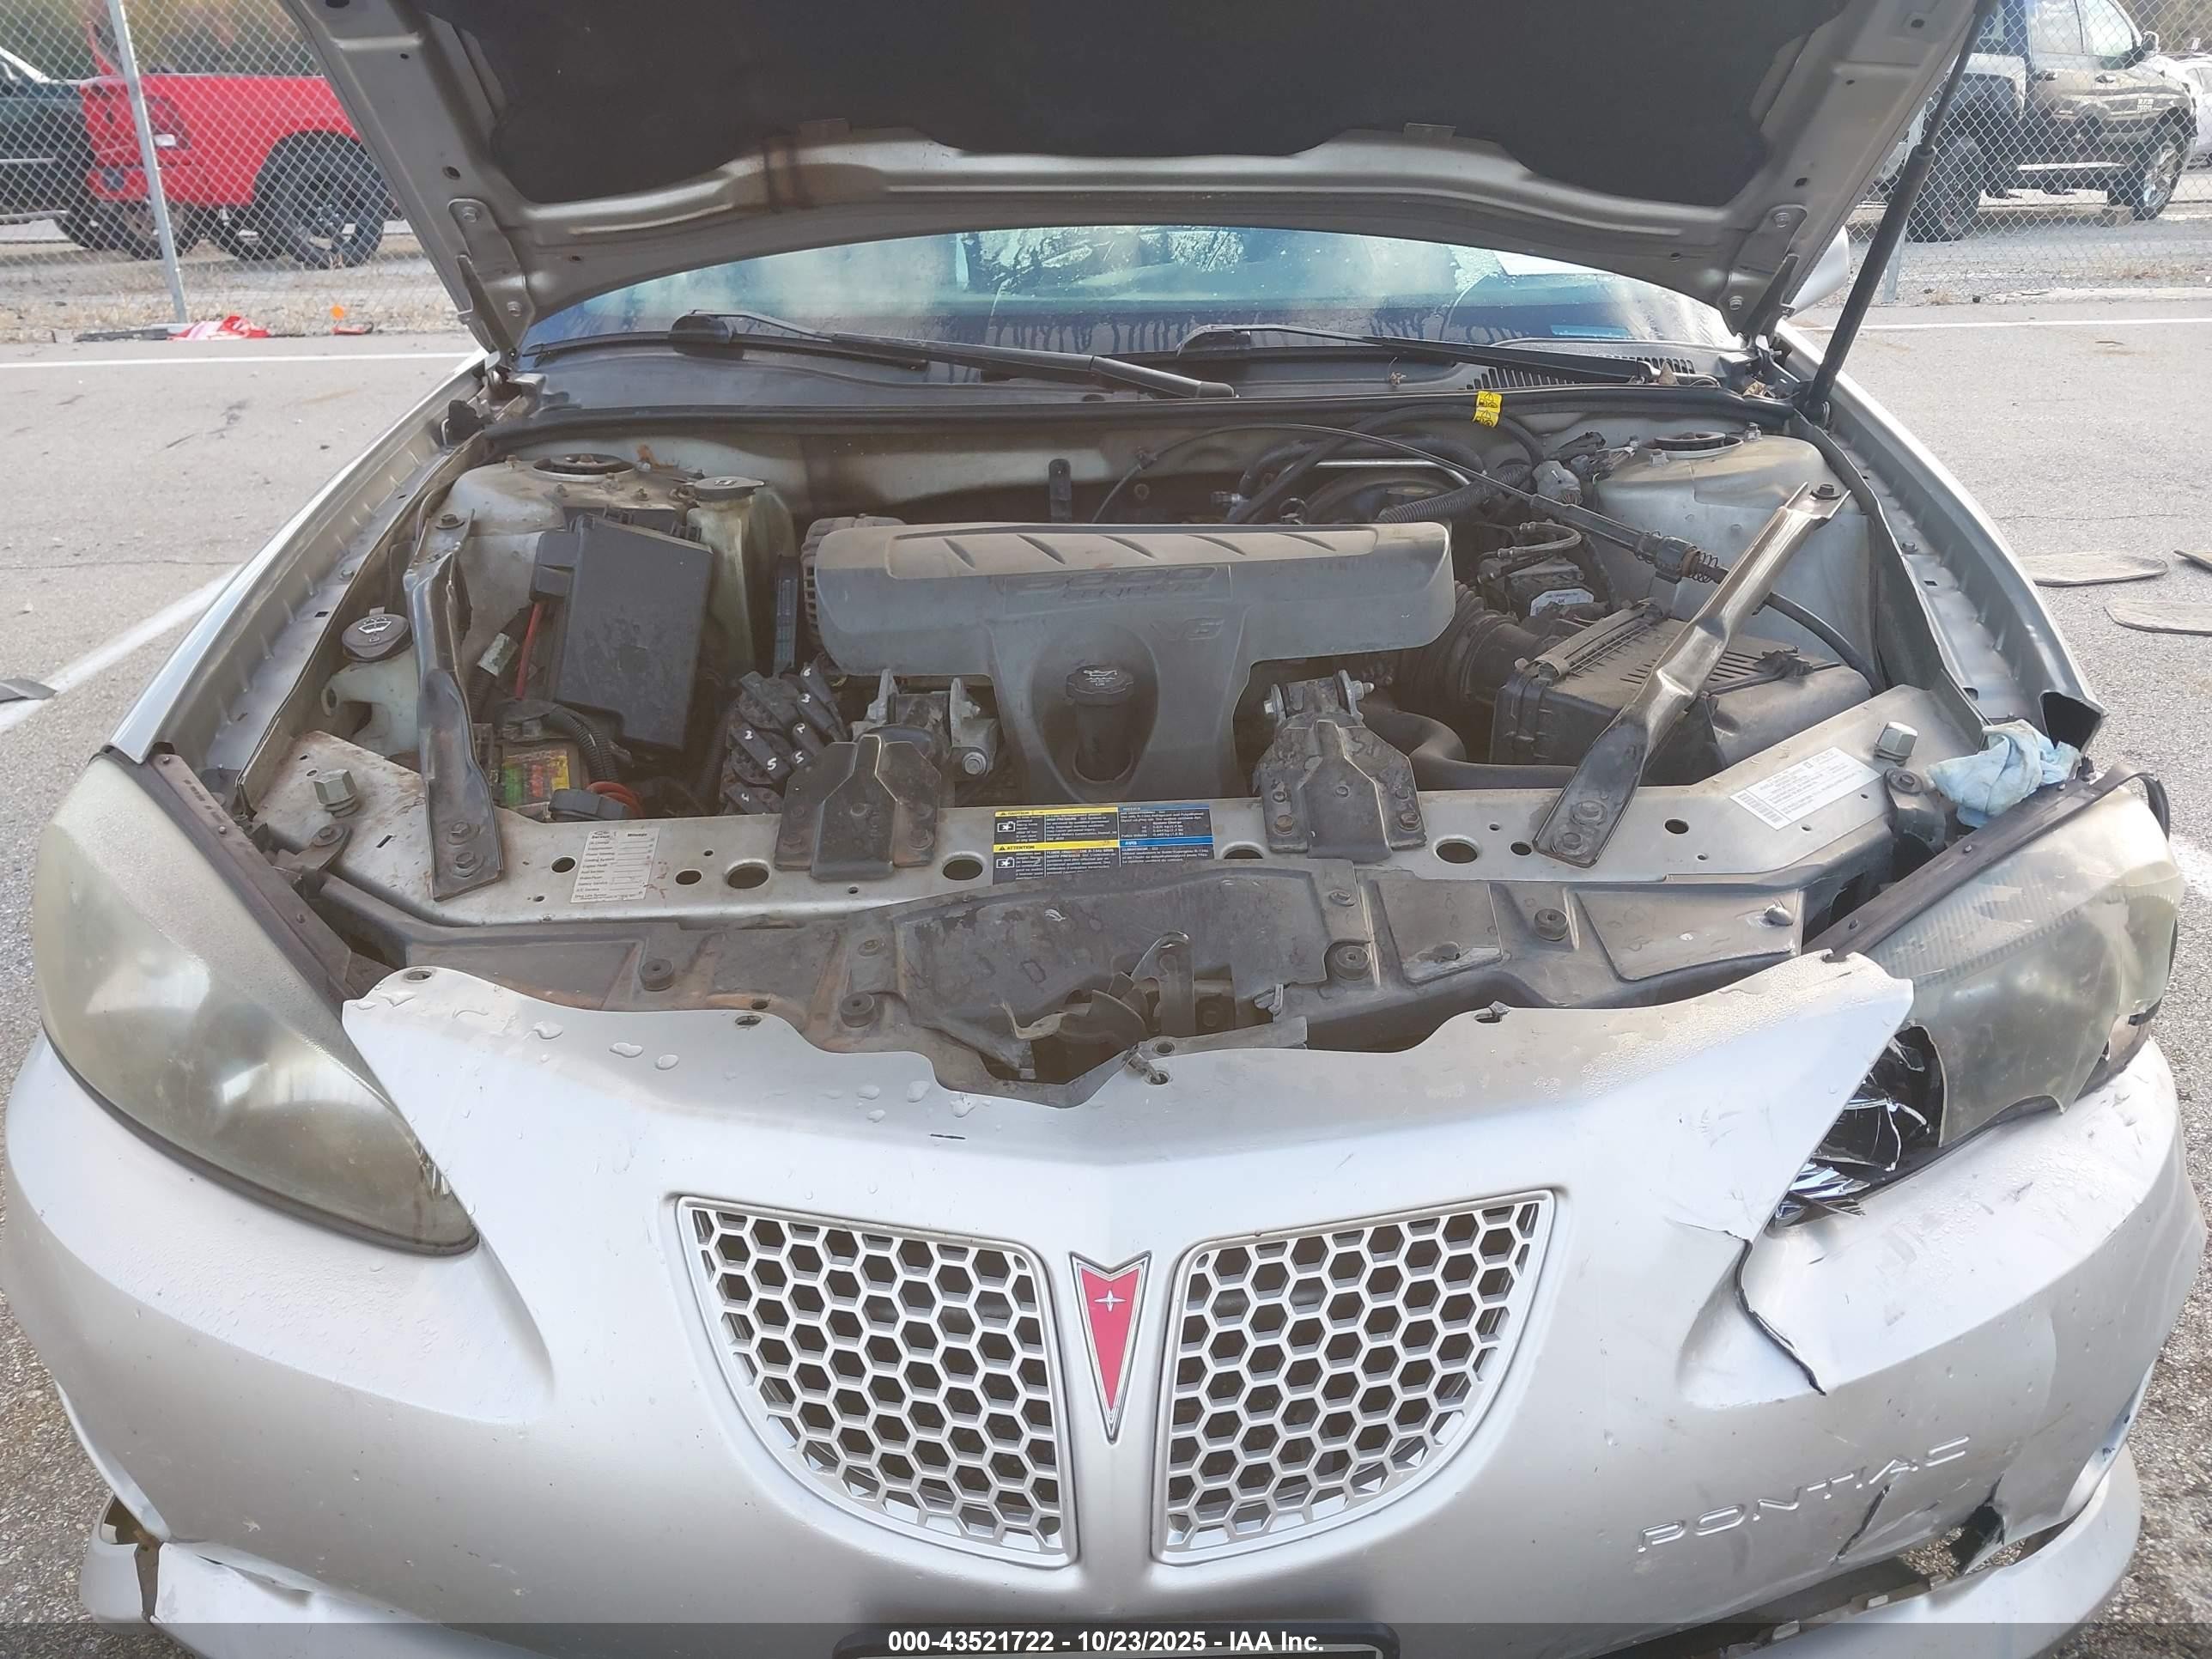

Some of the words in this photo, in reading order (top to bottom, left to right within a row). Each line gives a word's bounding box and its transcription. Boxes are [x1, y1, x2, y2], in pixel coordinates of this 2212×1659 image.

[803, 667, 811, 677] 6
[800, 693, 811, 703] 3
[744, 729, 753, 740] 2
[794, 750, 805, 763] 5
[767, 757, 777, 770] 5
[741, 793, 750, 802] 4
[1637, 1434, 1971, 1553] PONTIAC
